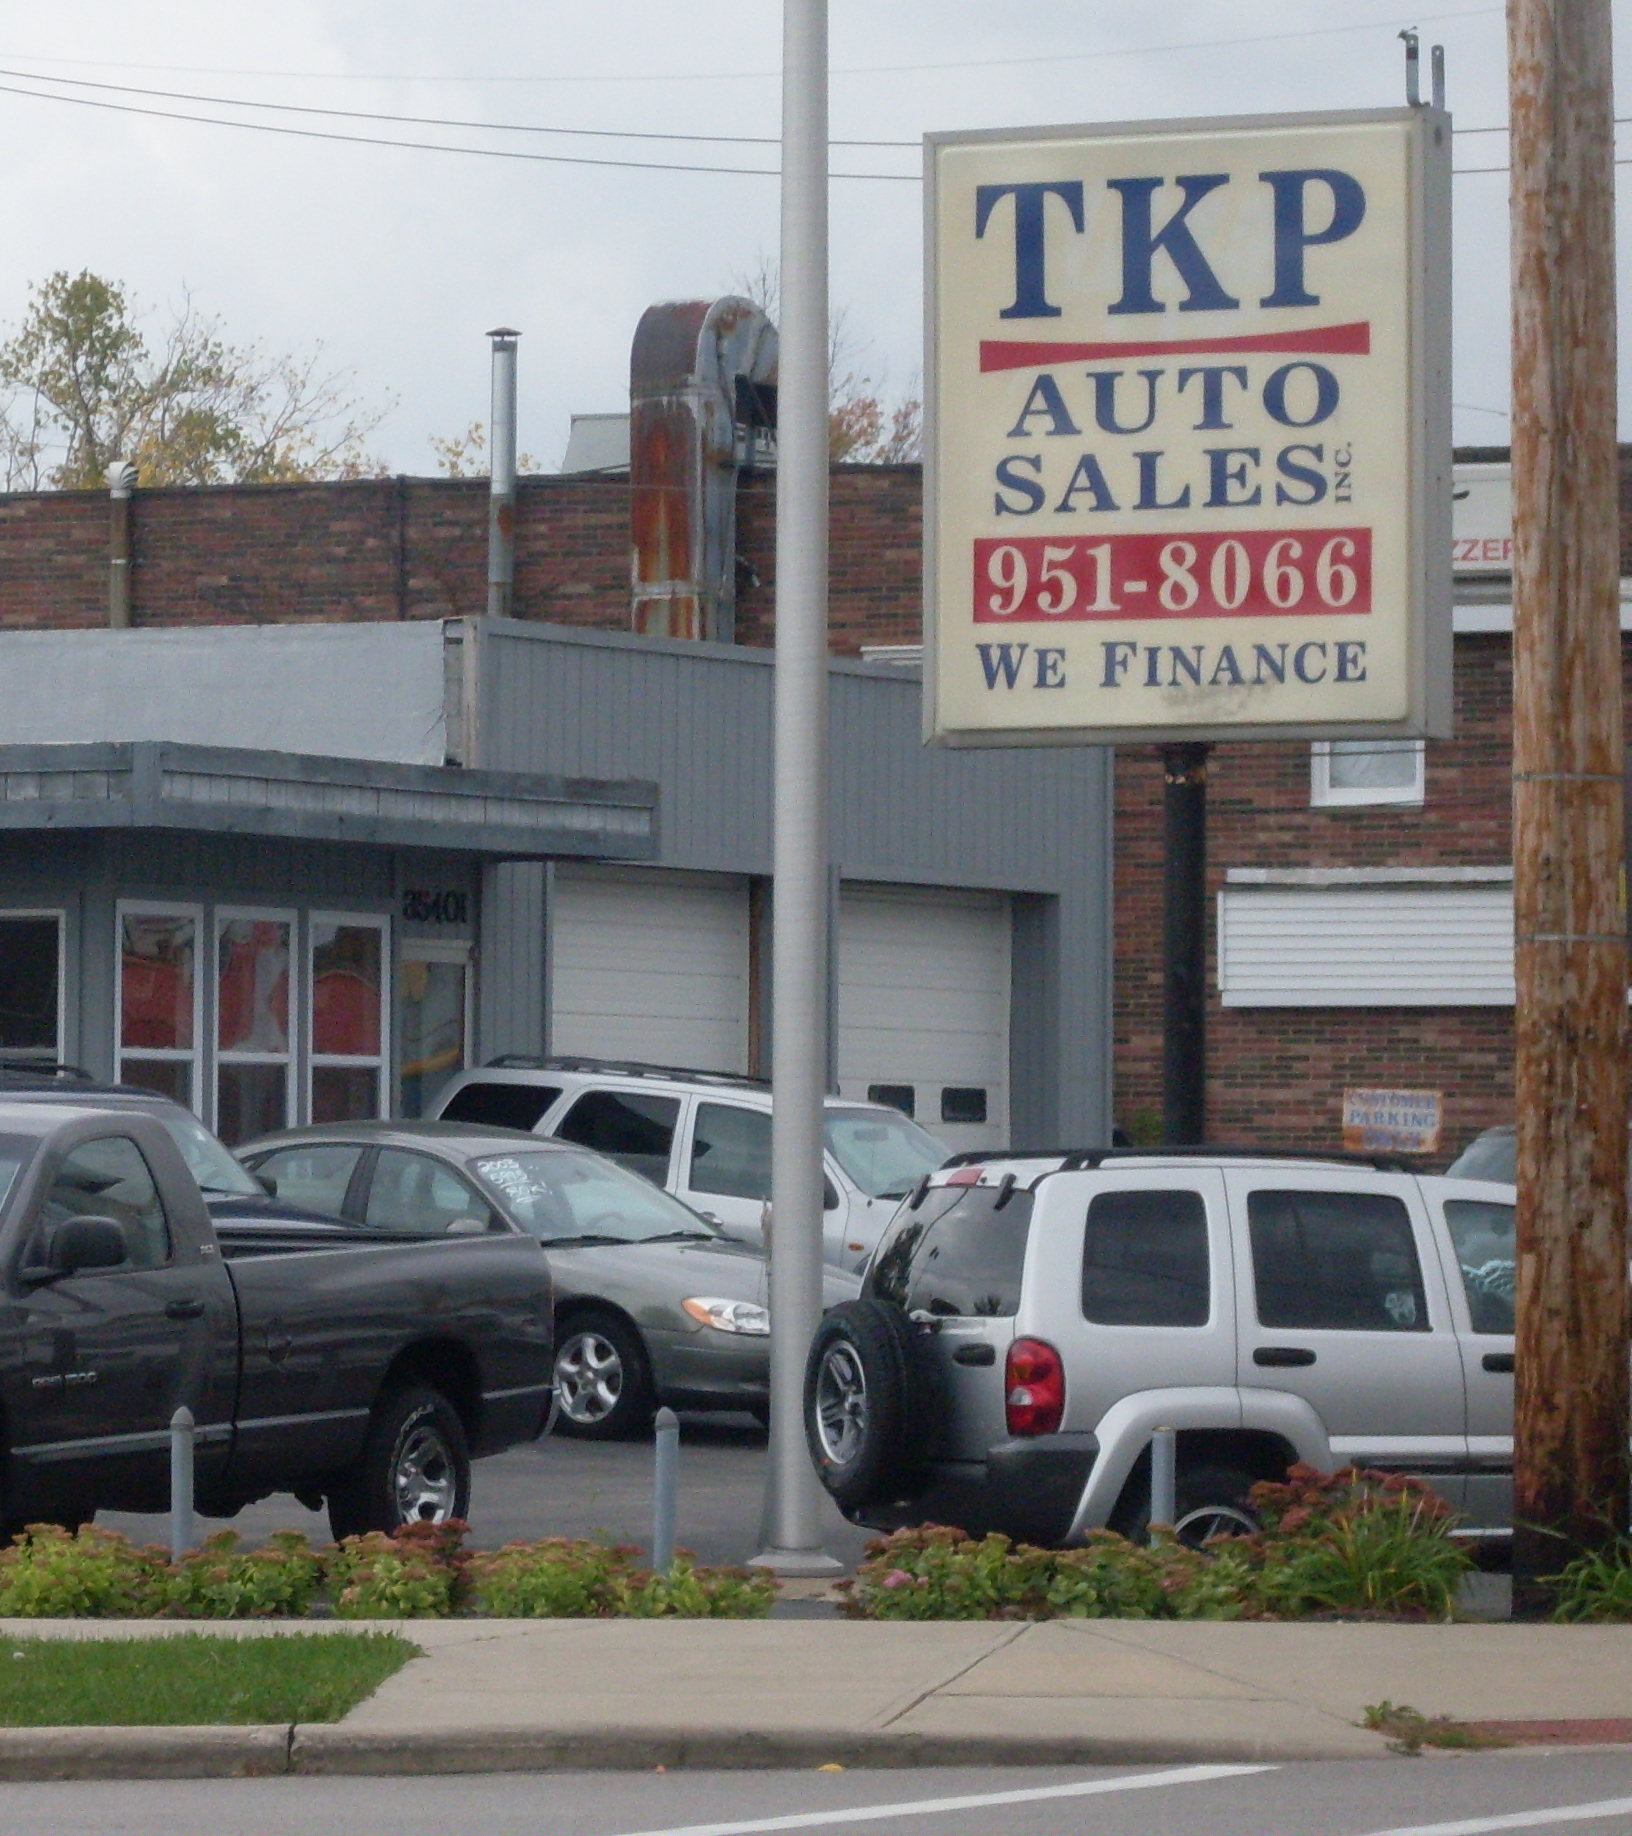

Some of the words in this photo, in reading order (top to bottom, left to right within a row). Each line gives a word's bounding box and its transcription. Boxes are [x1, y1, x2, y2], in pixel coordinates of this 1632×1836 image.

[974, 168, 1367, 320] TKP
[1006, 360, 1340, 438] AUTO
[994, 443, 1329, 517] SALES
[1334, 441, 1353, 504] INC.
[988, 537, 1358, 615] 951-8066
[977, 642, 1066, 690] WE
[1099, 641, 1367, 689] FINANCE
[1350, 1109, 1436, 1128] PARKING
